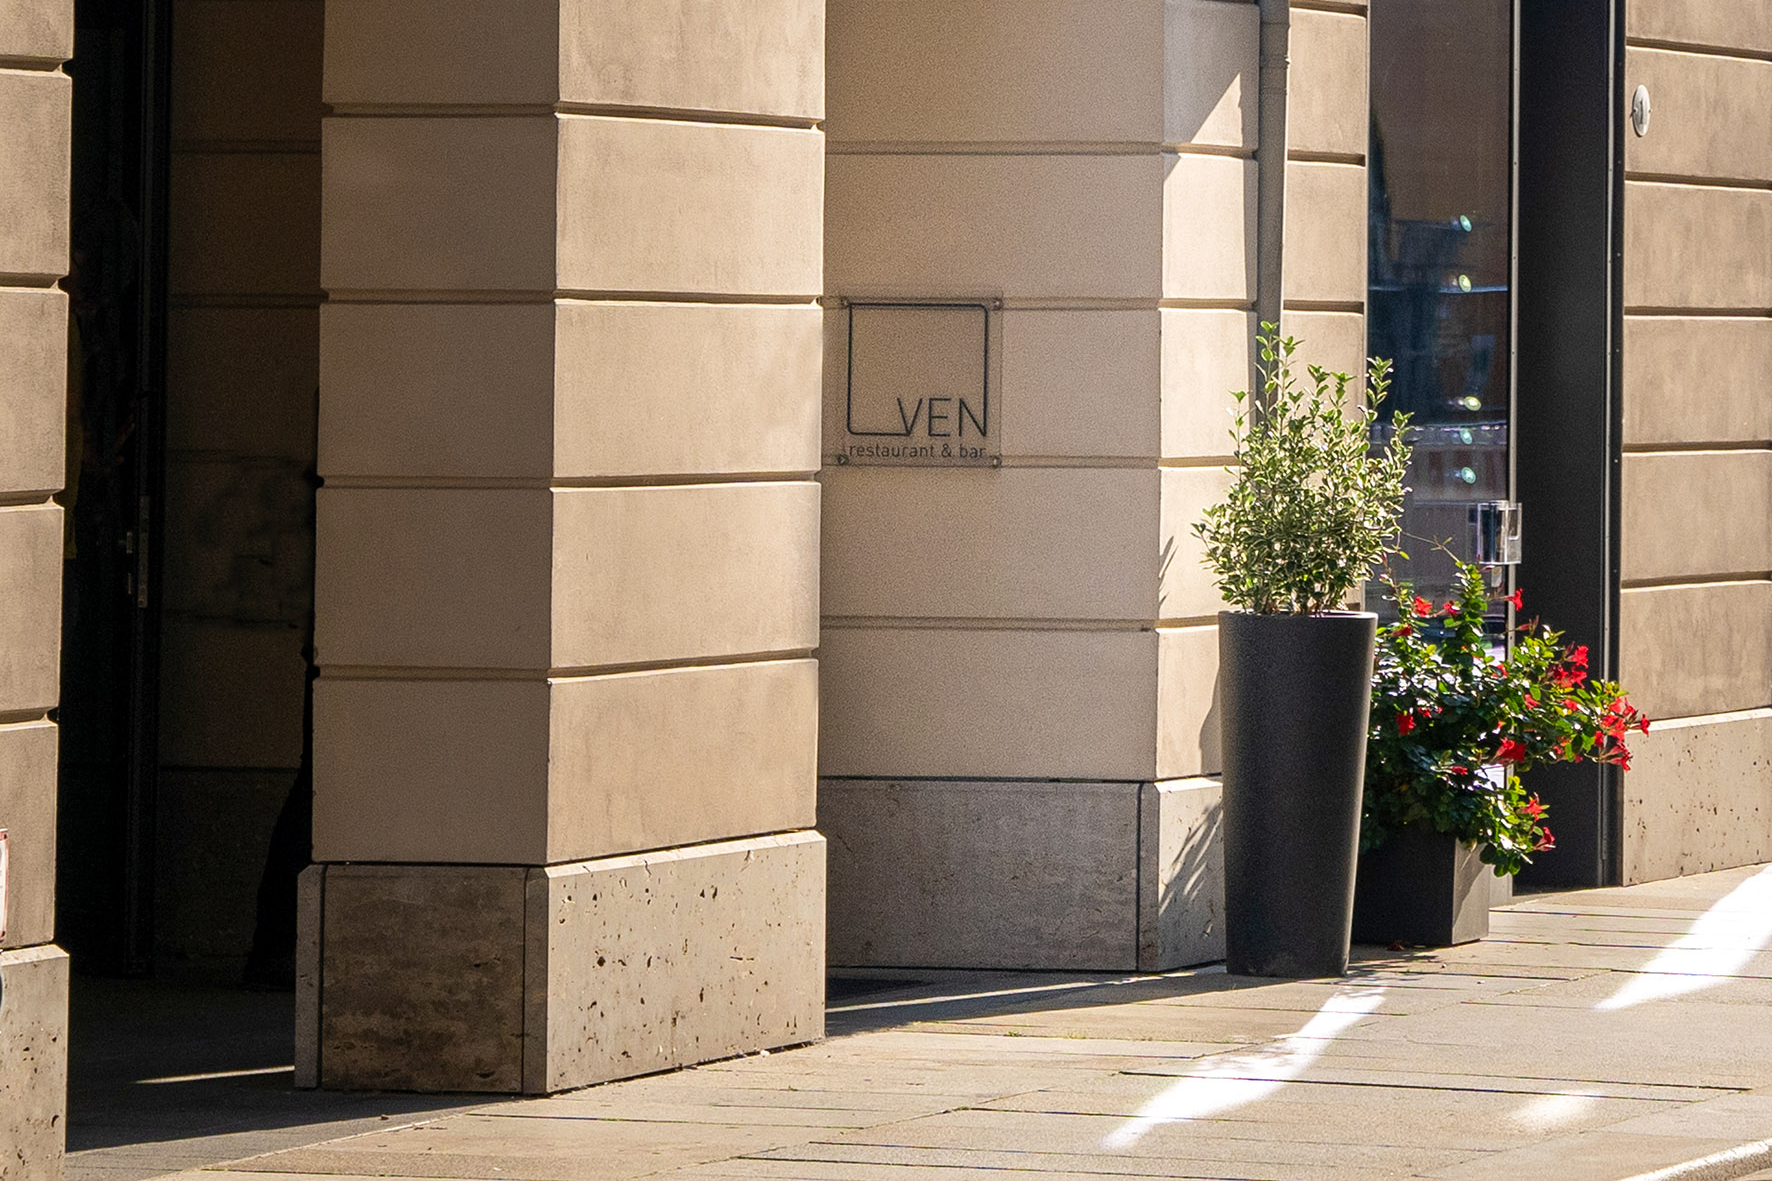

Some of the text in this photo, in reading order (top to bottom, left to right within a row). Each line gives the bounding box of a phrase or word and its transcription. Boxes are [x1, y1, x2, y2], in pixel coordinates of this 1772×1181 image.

[896, 397, 987, 437] VEN
[849, 443, 987, 459] restaurant & bar
